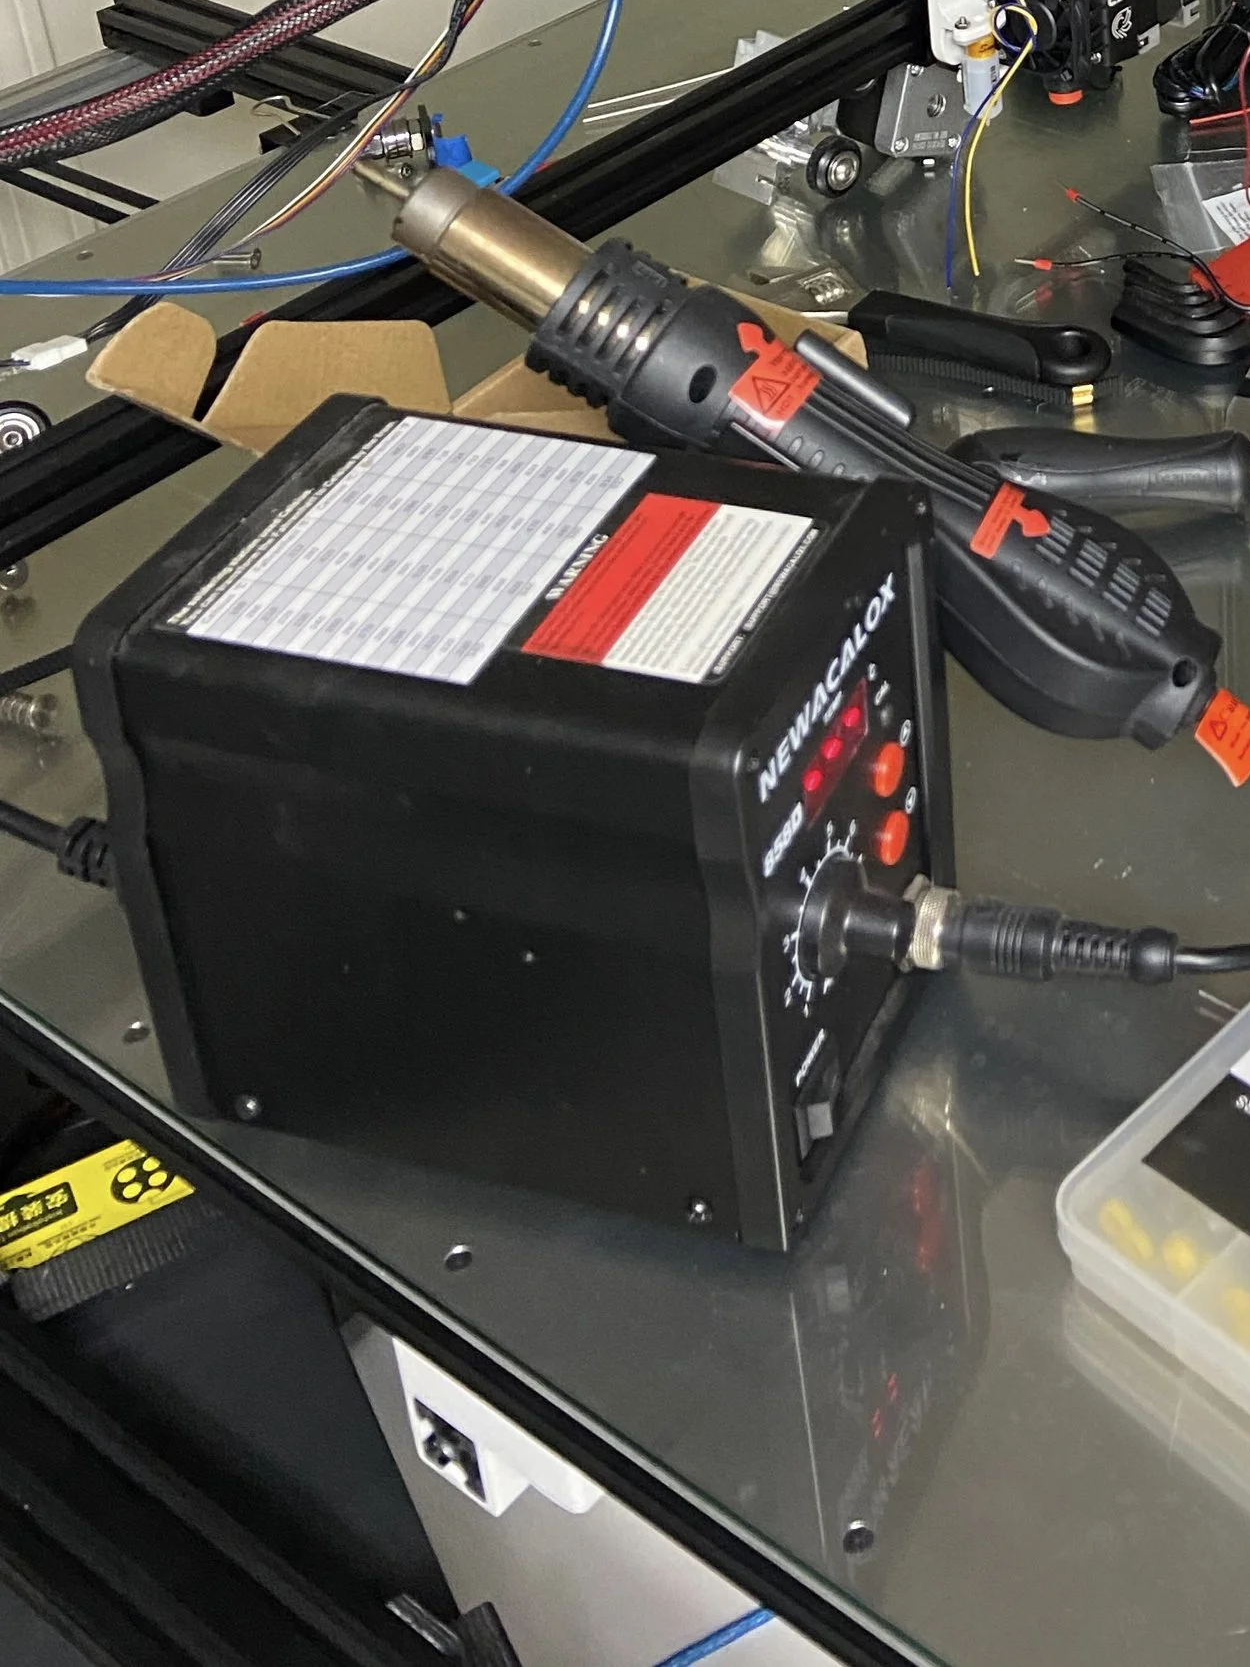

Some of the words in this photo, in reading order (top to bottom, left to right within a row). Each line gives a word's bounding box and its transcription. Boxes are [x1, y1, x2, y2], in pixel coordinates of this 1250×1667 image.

[545, 533, 610, 601] WARNING
[759, 572, 895, 803] NEWACALOX
[763, 801, 804, 878] 858D
